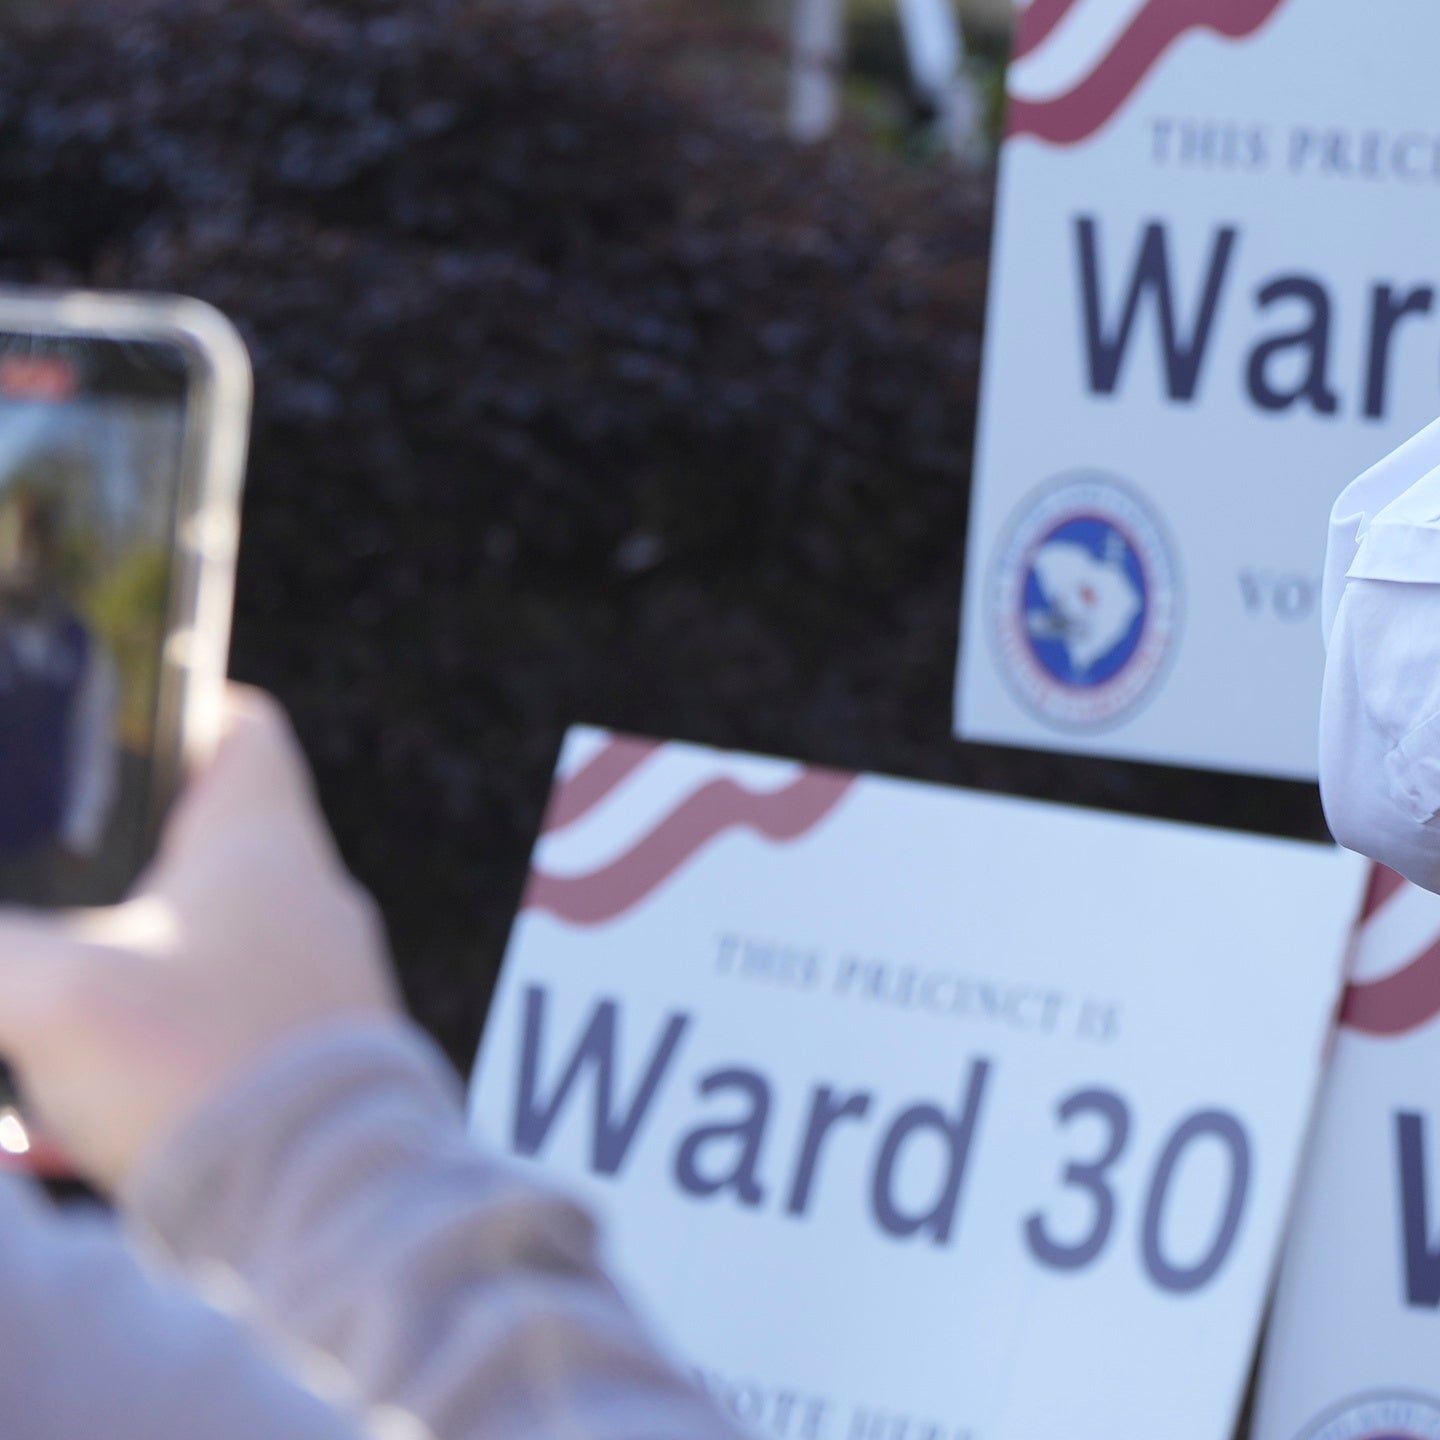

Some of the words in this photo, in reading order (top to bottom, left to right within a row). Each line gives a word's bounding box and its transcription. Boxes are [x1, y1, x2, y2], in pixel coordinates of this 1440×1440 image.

[1149, 119, 1266, 170] THIS
[1236, 570, 1323, 621] VO
[716, 933, 822, 990] THIS
[836, 954, 1067, 1032] PRECINCT
[1077, 997, 1120, 1042] IS
[510, 981, 994, 1250] Ward
[1021, 1087, 1259, 1296] 30
